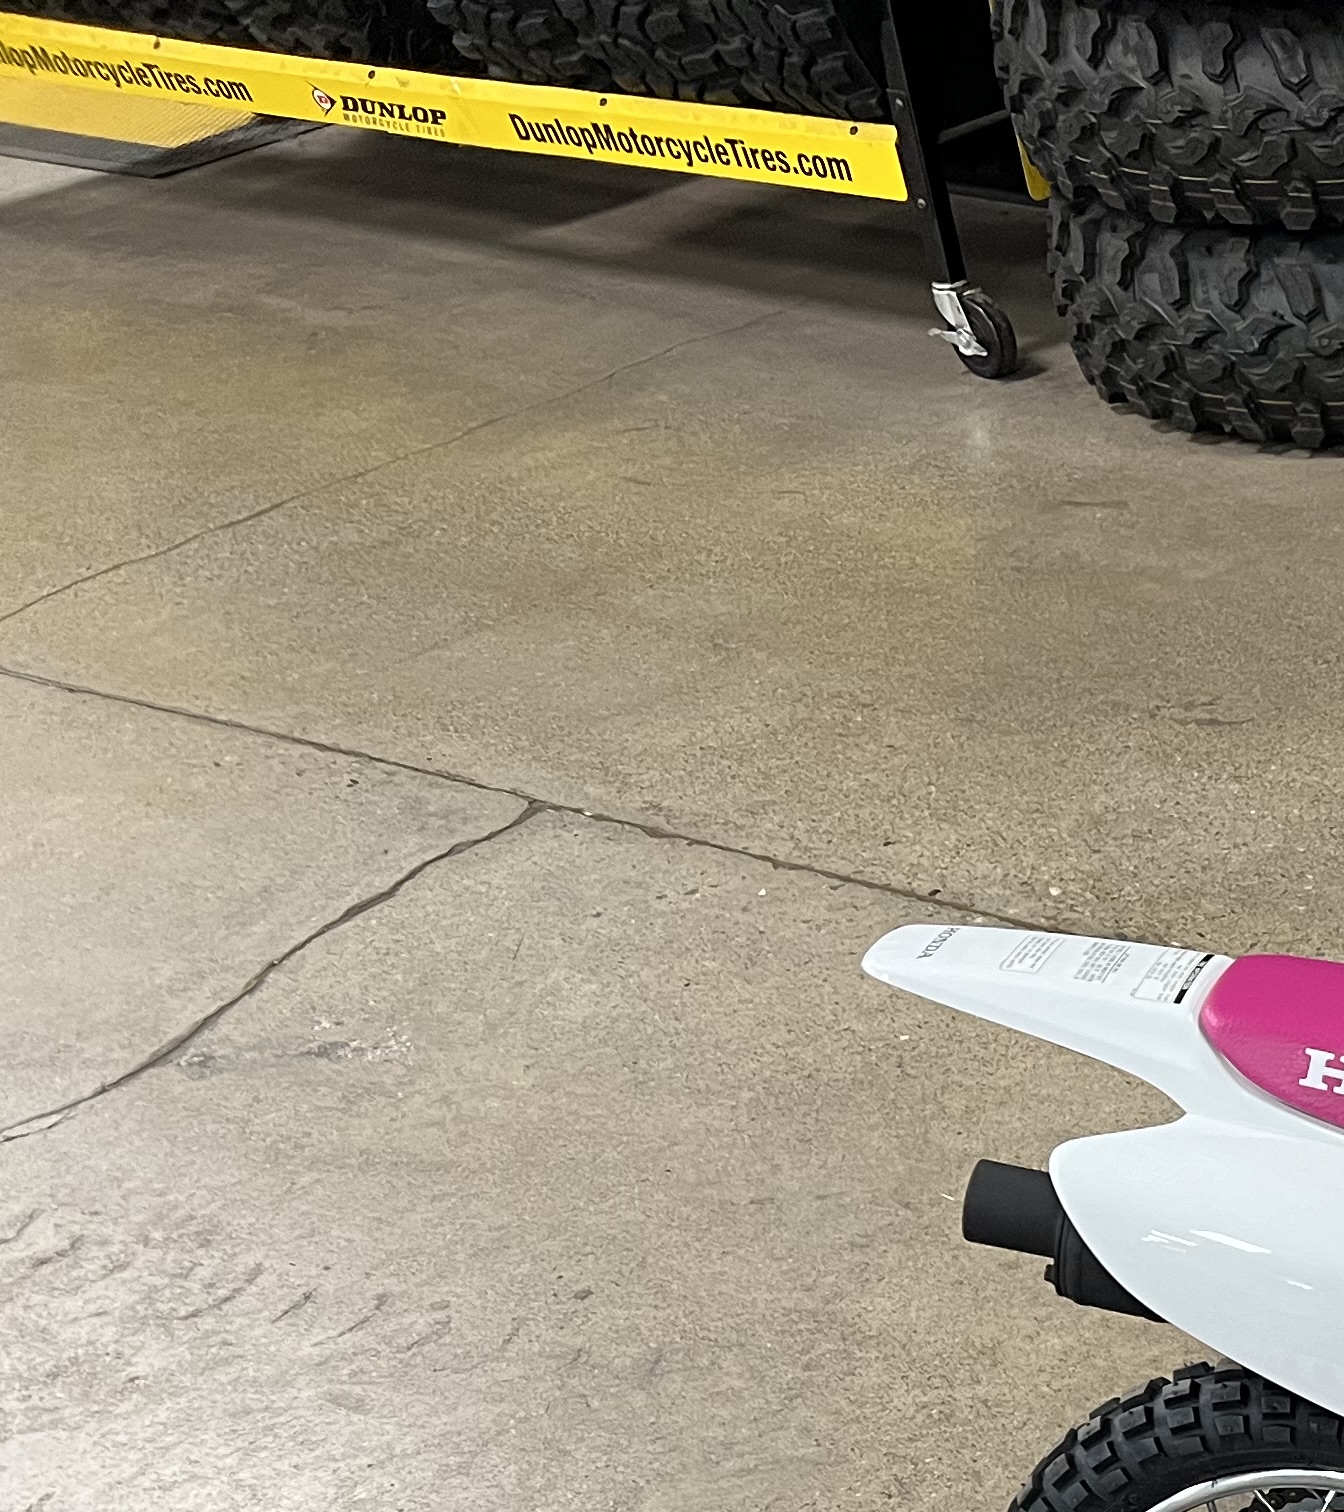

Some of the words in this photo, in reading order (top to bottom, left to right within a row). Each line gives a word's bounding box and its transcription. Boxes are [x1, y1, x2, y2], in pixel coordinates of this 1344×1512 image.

[0, 40, 253, 102] lopMotorcycleTires.com
[340, 95, 447, 126] DUNLOP
[343, 112, 411, 133] MOTORCYCLE
[508, 112, 853, 182] DunlopMotorcycleTires.com
